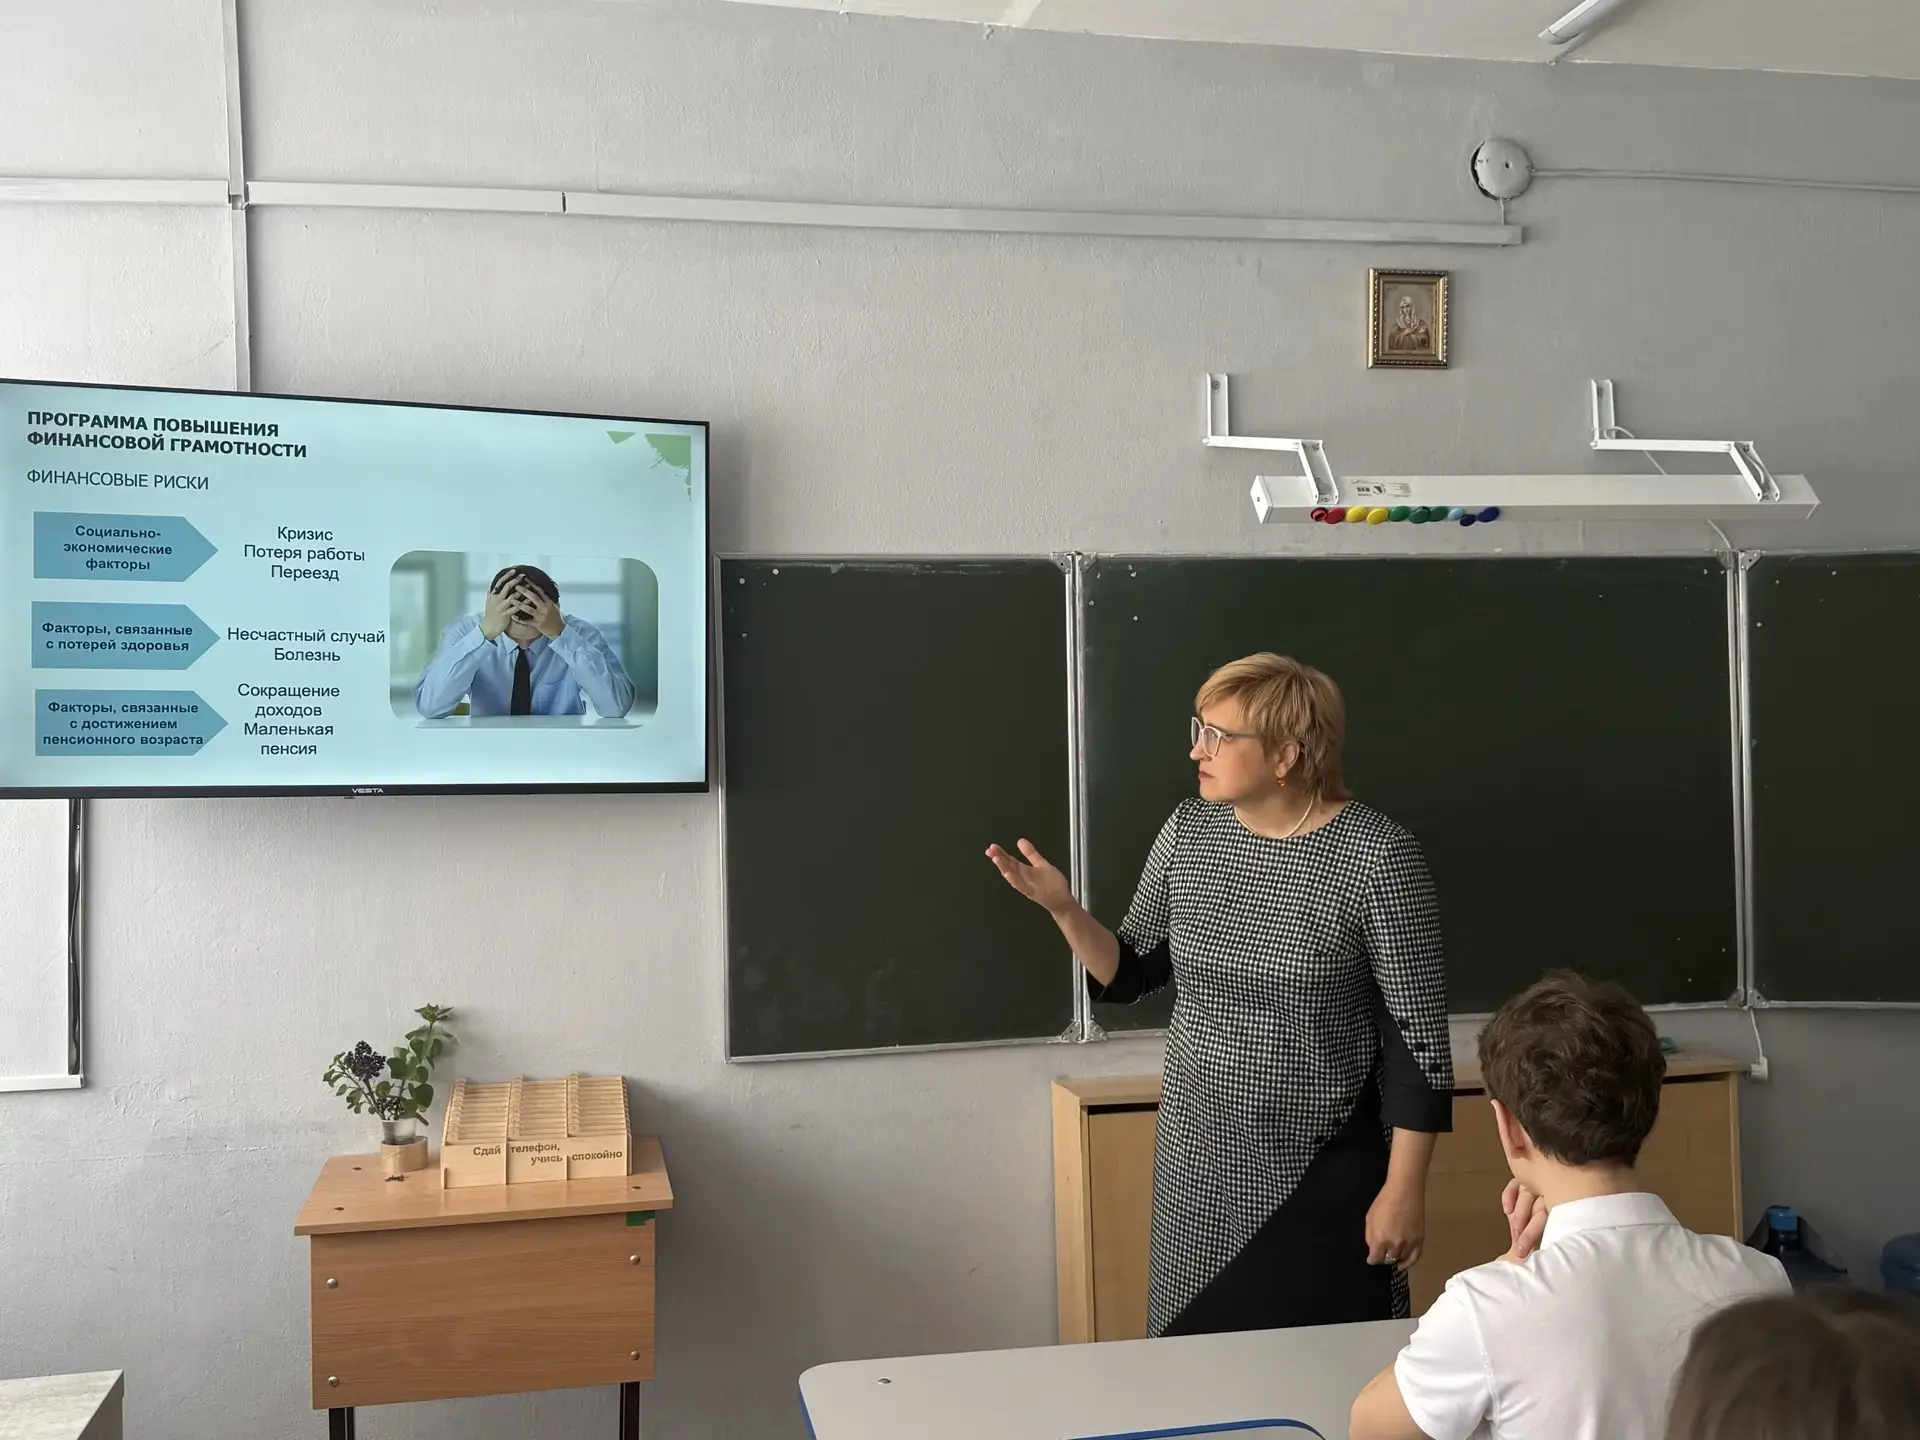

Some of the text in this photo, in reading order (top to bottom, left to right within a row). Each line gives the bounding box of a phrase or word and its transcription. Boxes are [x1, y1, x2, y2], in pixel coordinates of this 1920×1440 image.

[28, 411, 279, 437] ПРОГРАММА ПОВЫШЕНИЯ
[27, 432, 307, 458] ФИНАНСОВОЙ ГРАМОТНОСТИ
[27, 469, 209, 489] ФИНАНСОВЫЕ РИСКИ
[75, 525, 161, 541] Социально-
[278, 526, 333, 544] Кризис
[63, 543, 172, 555] экономические
[244, 544, 365, 564] Потеря работы
[86, 557, 150, 572] факторы
[271, 565, 339, 582] Переезд
[42, 622, 192, 636] Факторы, связанные
[228, 627, 385, 647] Несчастный случай
[46, 638, 189, 653] с потерей здоровья
[274, 648, 340, 662] Болезнь
[238, 684, 340, 700] Сокращение
[48, 702, 199, 715] Факторы, связанные
[255, 704, 322, 719] доходов
[69, 720, 178, 731] с достижением
[244, 722, 333, 736] Маленькая
[43, 735, 203, 748] пенсионного возраста
[261, 743, 317, 755] пенсия
[473, 1143, 560, 1157] Сдай телефон,
[531, 1150, 622, 1165] учись спокойно
